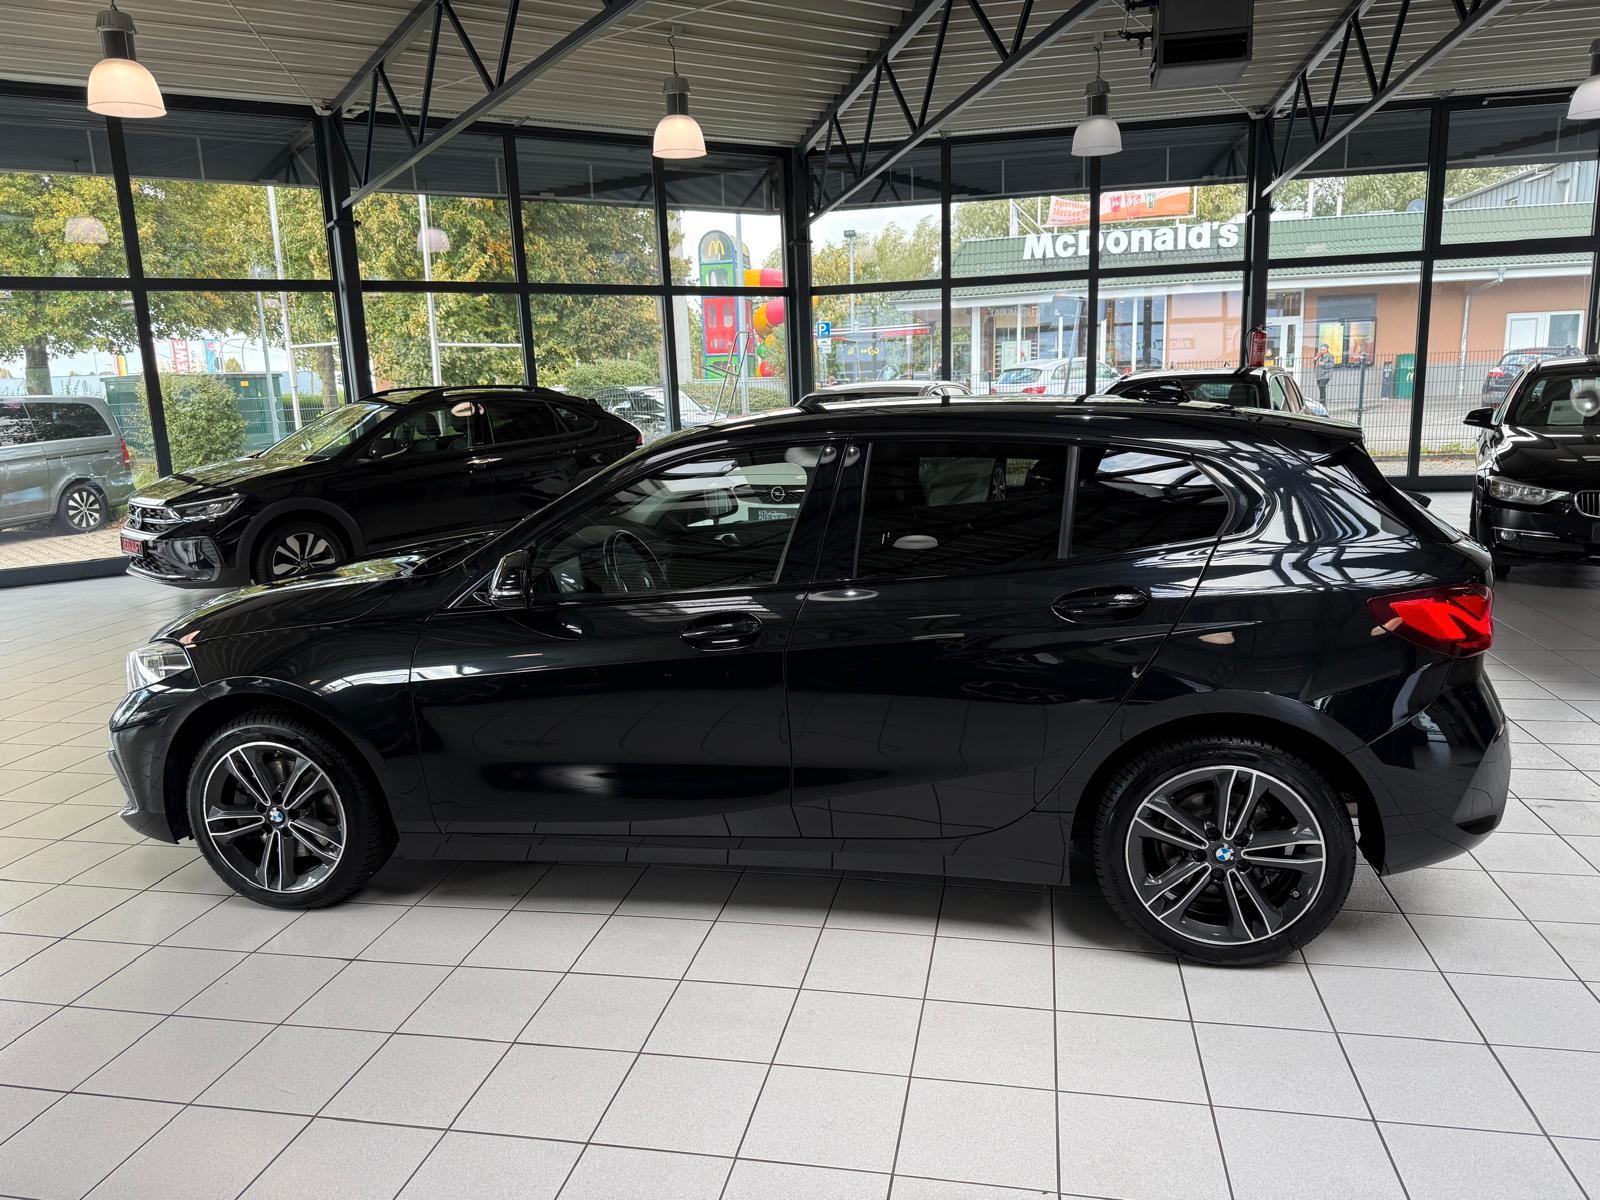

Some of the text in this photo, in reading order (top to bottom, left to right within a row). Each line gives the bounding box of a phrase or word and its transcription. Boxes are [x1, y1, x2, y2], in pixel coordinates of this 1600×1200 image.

[1022, 221, 1239, 260] McDonald's
[819, 324, 827, 335] P
[175, 341, 188, 371] EWE
